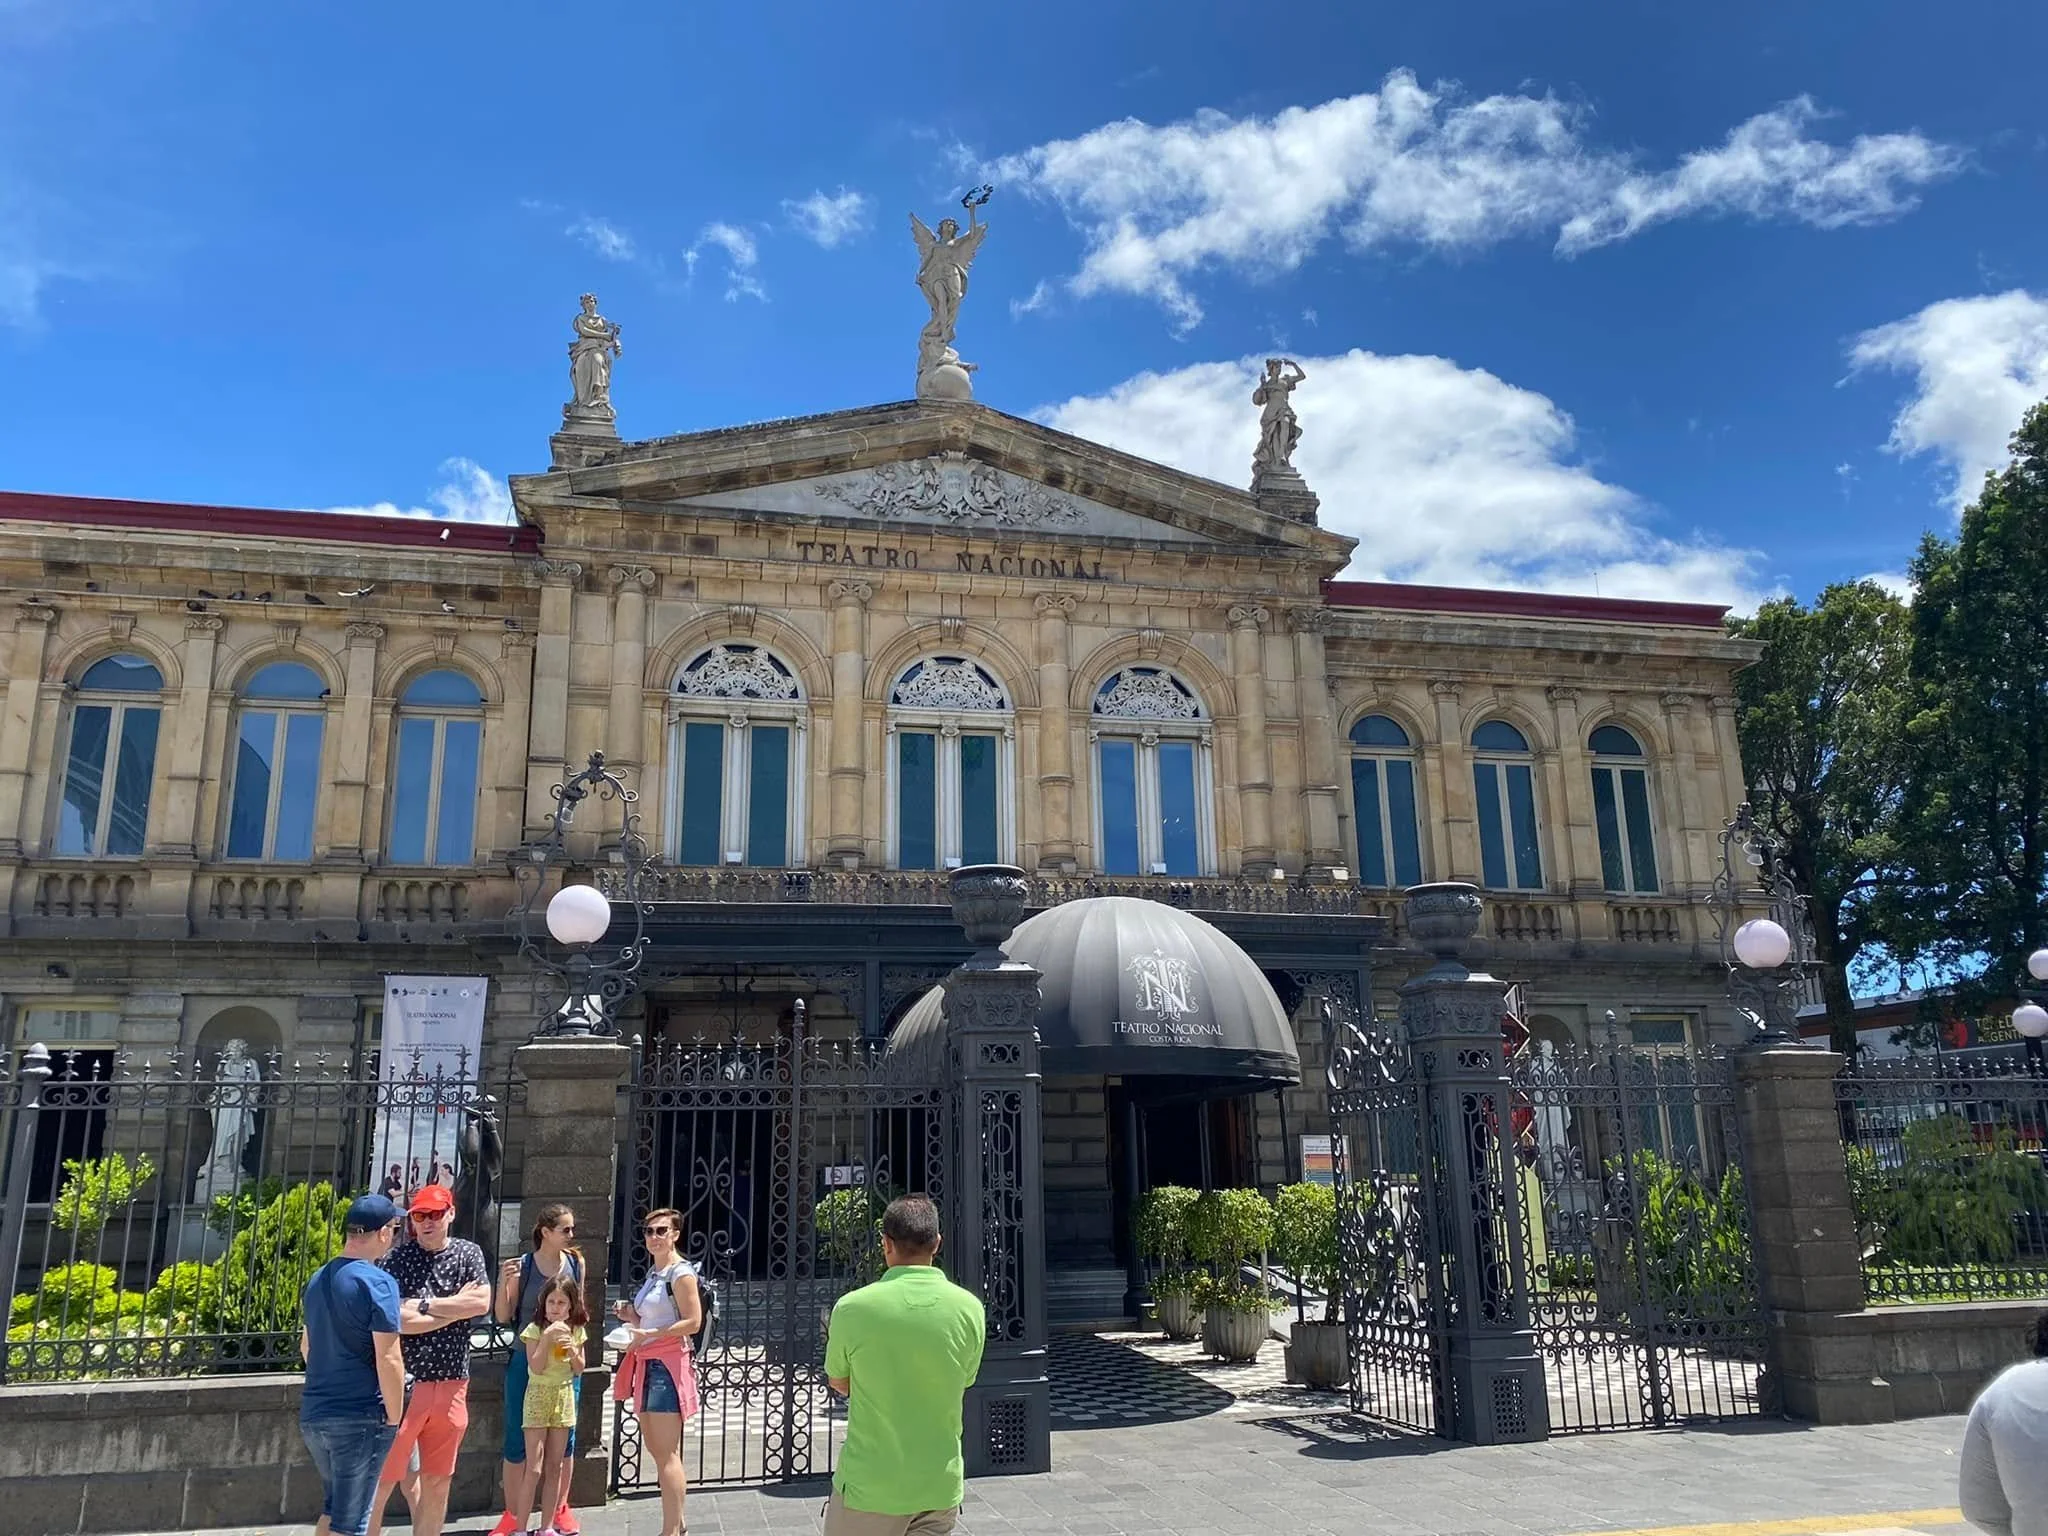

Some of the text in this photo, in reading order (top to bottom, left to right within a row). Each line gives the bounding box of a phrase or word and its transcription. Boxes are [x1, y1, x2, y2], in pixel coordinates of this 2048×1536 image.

[796, 541, 1108, 580] TEATRO NACIONAL
[1112, 1021, 1224, 1036] TEATRO NACIONAL
[1148, 1035, 1192, 1044] COSTA RICA
